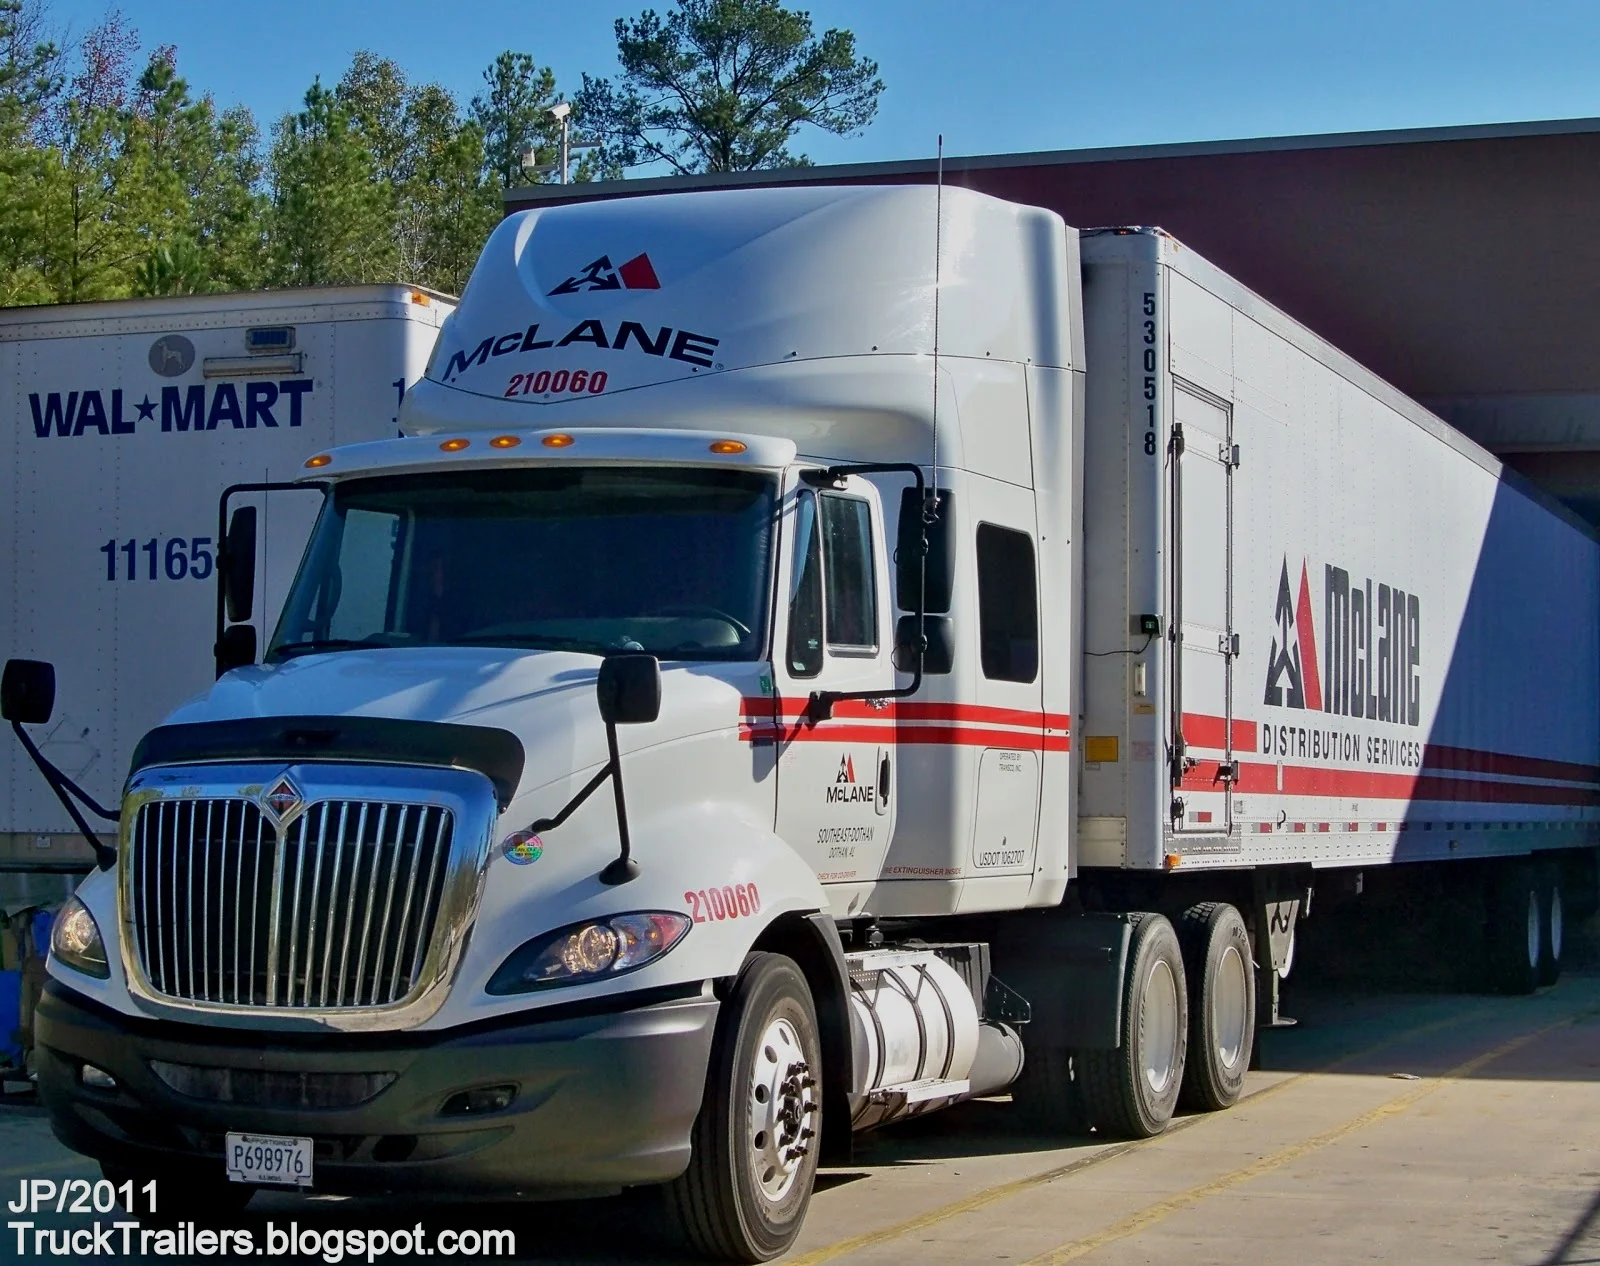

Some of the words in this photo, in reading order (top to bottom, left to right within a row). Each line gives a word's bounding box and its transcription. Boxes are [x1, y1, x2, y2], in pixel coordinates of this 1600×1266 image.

[504, 370, 608, 398] 210060
[100, 537, 213, 581] 11165
[1263, 723, 1361, 762] DISTRIBUTION
[1366, 735, 1421, 767] SERVICES
[893, 866, 944, 875] EXTINGUISHER
[944, 867, 962, 876] INSIDE
[979, 851, 1001, 866] USDOT
[684, 882, 761, 924] 210060
[234, 1145, 304, 1174] P698976
